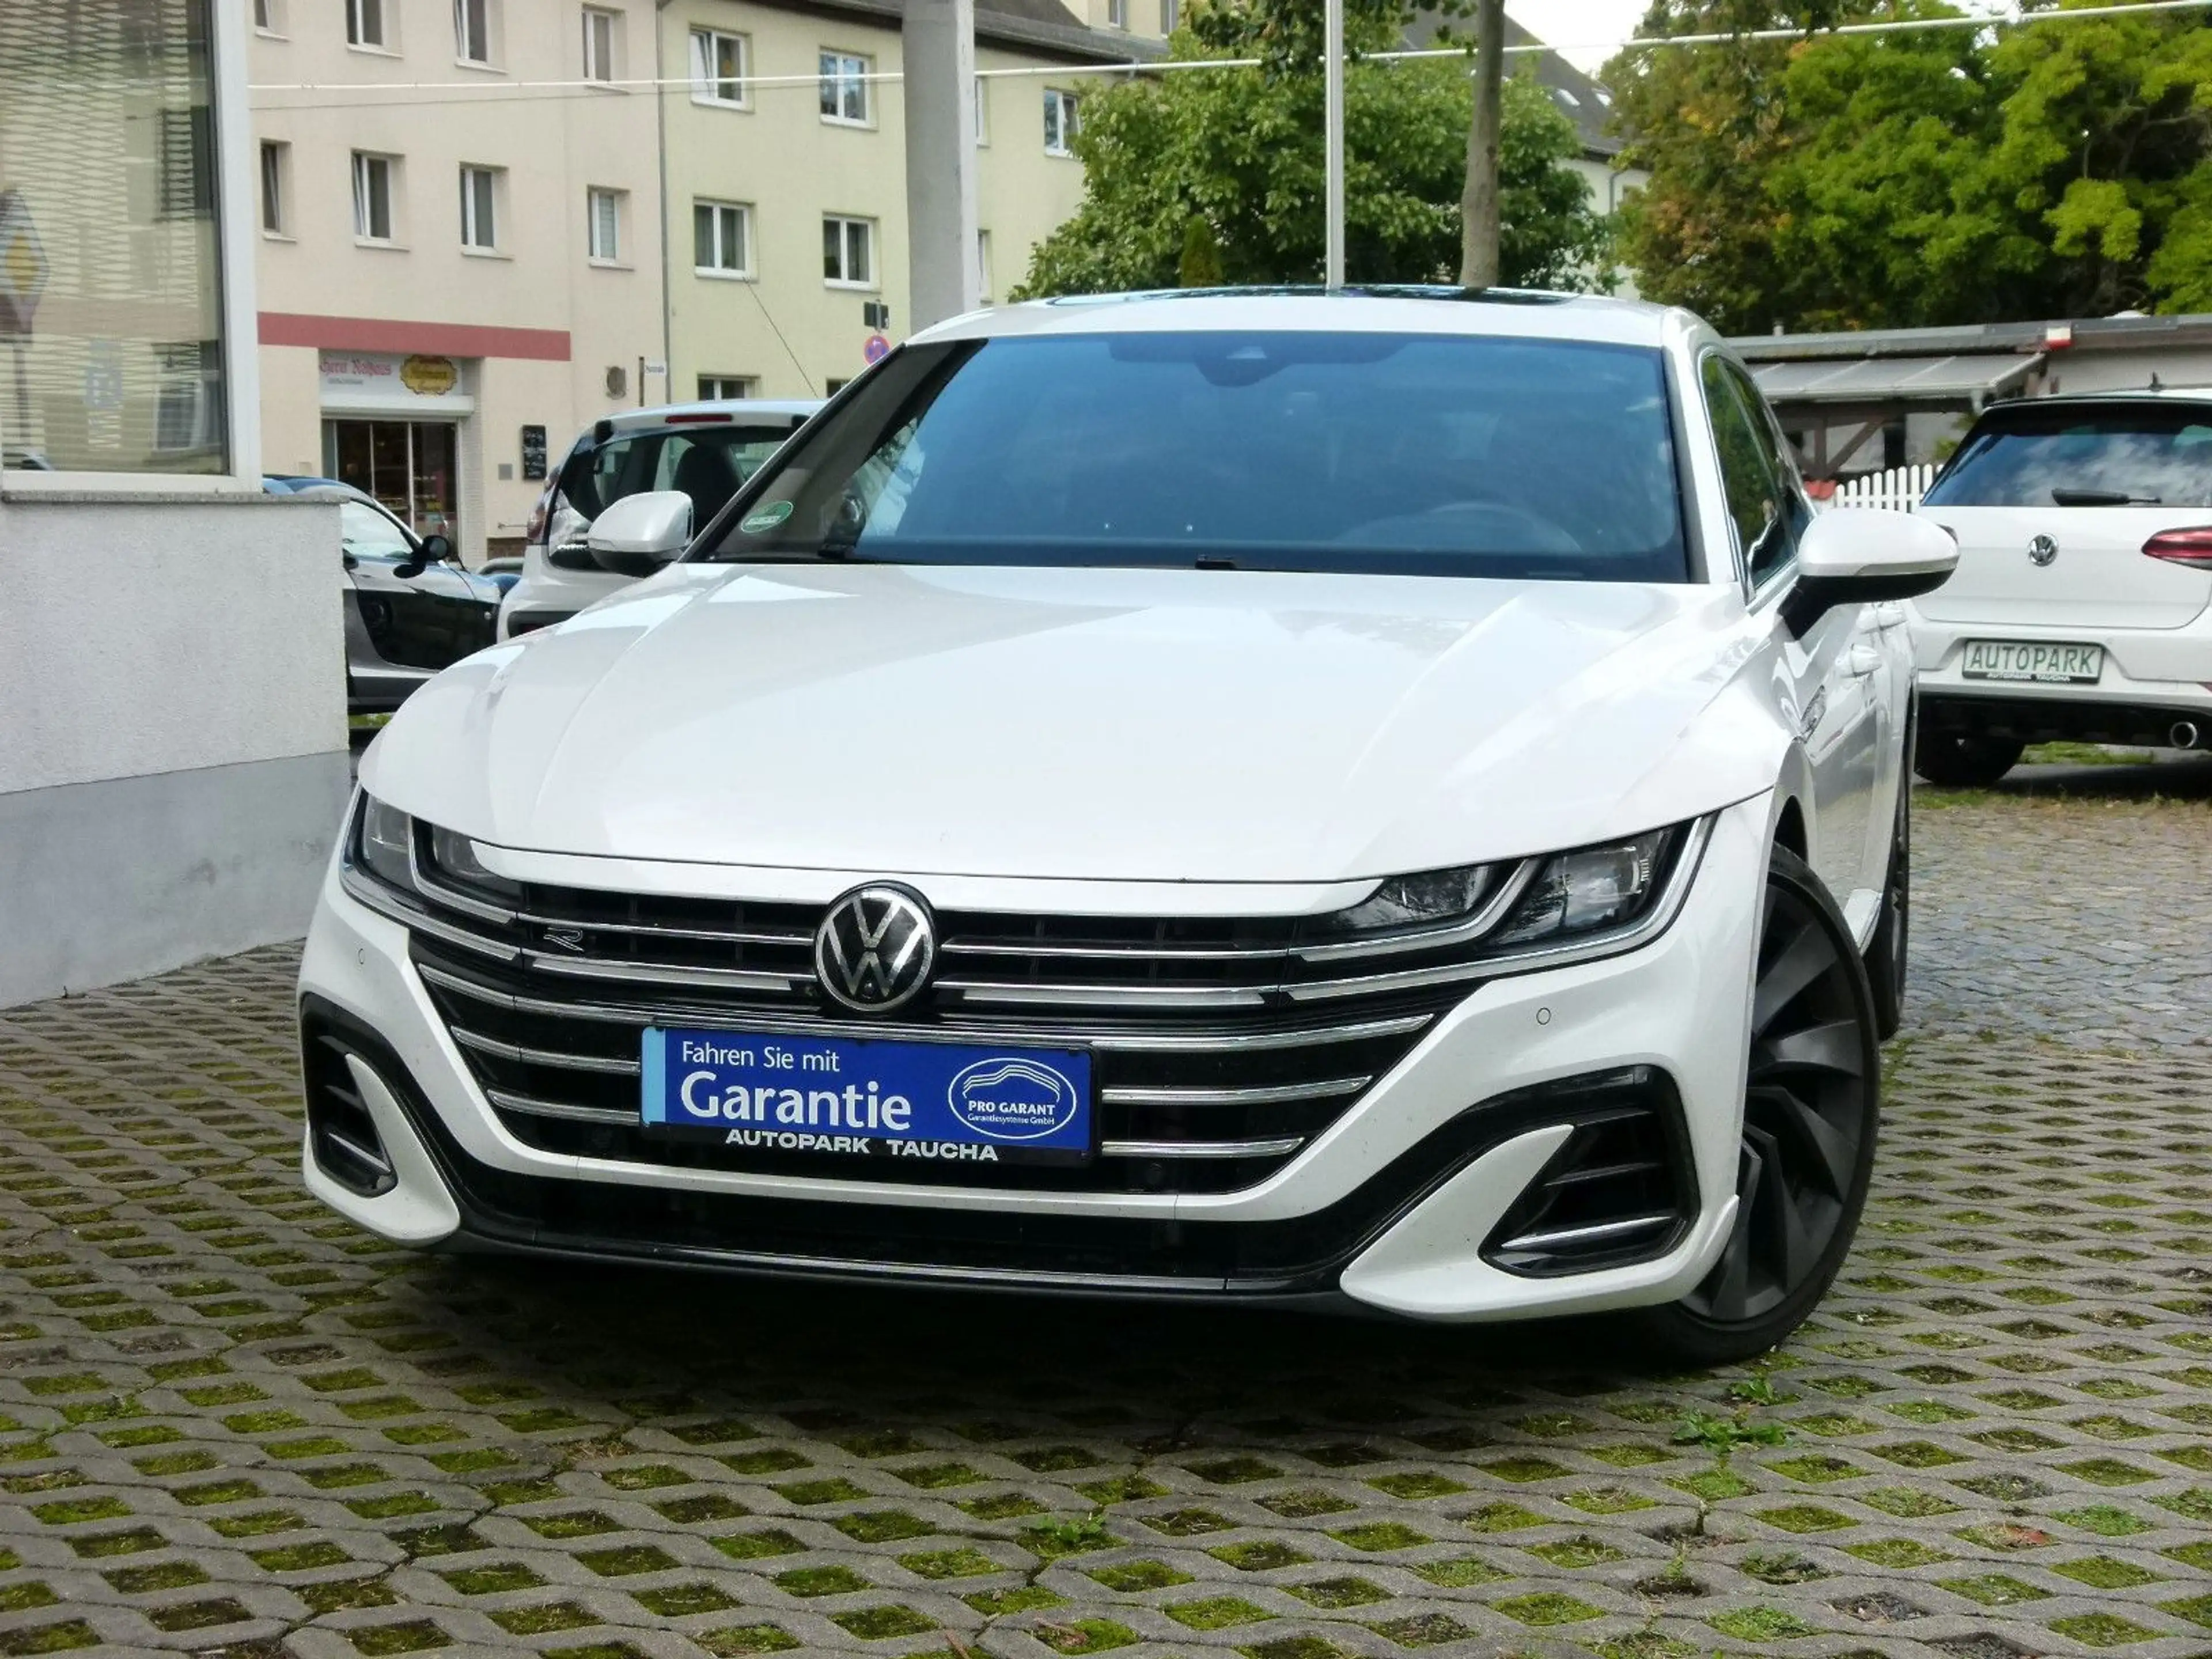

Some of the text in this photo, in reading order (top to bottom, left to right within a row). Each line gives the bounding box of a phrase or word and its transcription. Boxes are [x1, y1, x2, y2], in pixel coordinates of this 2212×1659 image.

[1970, 645, 2096, 673] AUTOPARK
[683, 1041, 840, 1072] Fahren Sie mit
[681, 1070, 911, 1130] Garantie
[968, 1100, 1056, 1115] PRO GARANT
[1030, 1117, 1055, 1125] GmbH
[725, 1128, 999, 1161] AUTOPARK TAUCHA
